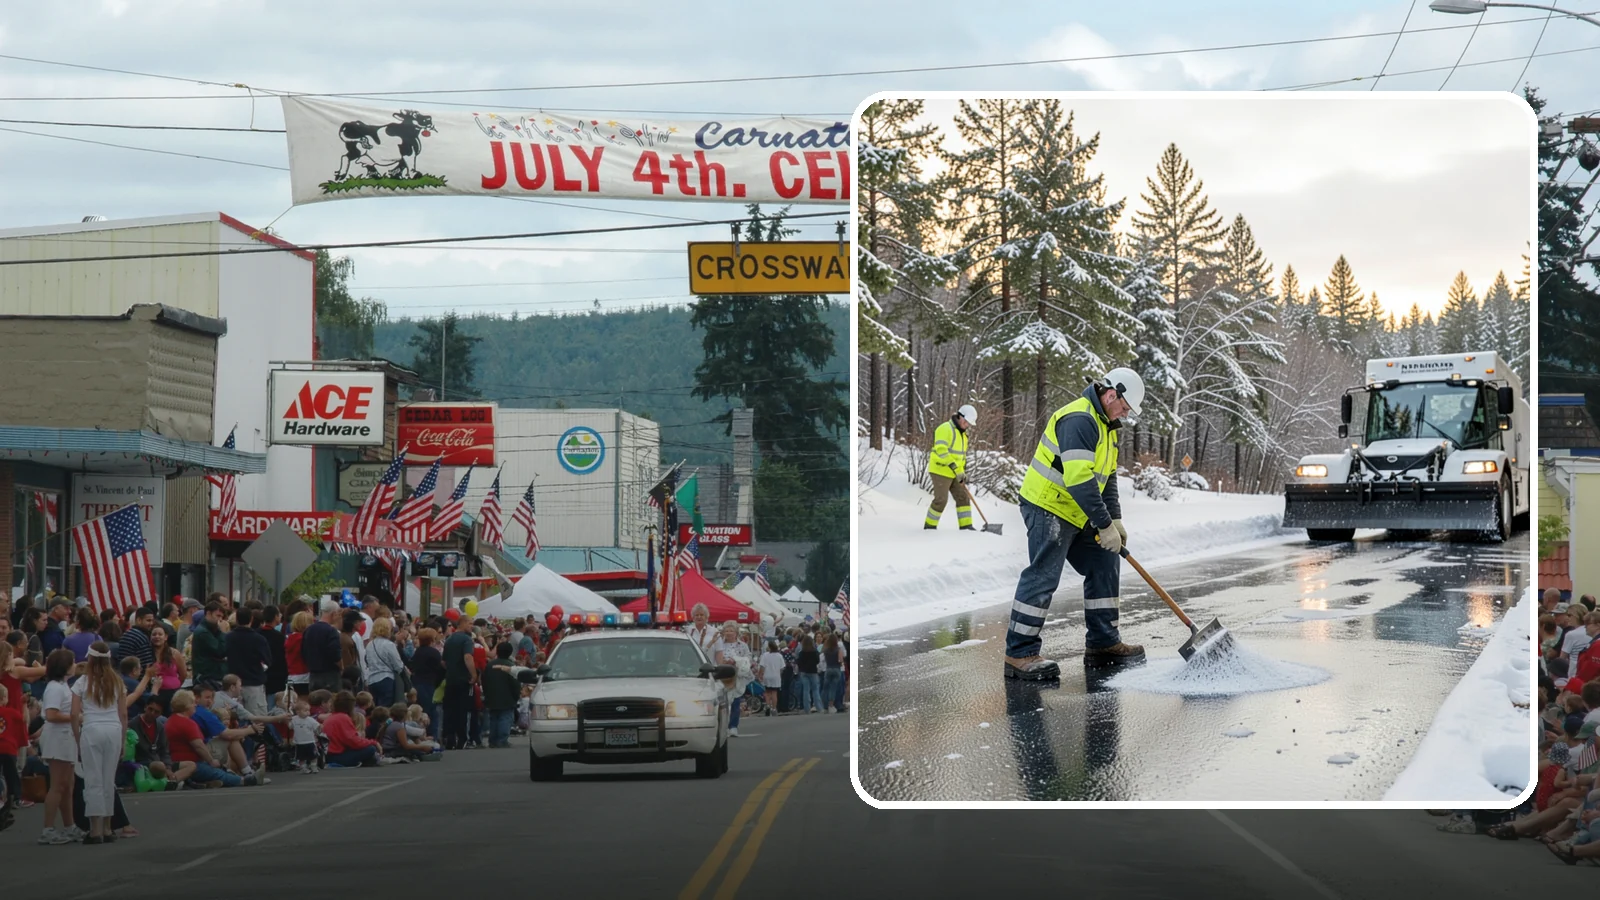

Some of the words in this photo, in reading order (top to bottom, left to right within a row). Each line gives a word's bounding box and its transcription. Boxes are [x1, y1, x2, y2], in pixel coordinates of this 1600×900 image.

[481, 141, 605, 193] JULY
[632, 150, 747, 199] 4th.
[697, 254, 850, 280] CROSSWA
[283, 380, 374, 420] ACE
[405, 409, 452, 423] CEDAR
[283, 421, 371, 436] Hardware
[416, 428, 477, 447] Coca-Cola
[83, 486, 94, 494] St.
[95, 486, 124, 495] Vincent
[126, 486, 136, 495] de
[137, 486, 155, 495] Paul
[688, 526, 741, 535] CRNATION
[699, 535, 730, 543] GLASS
